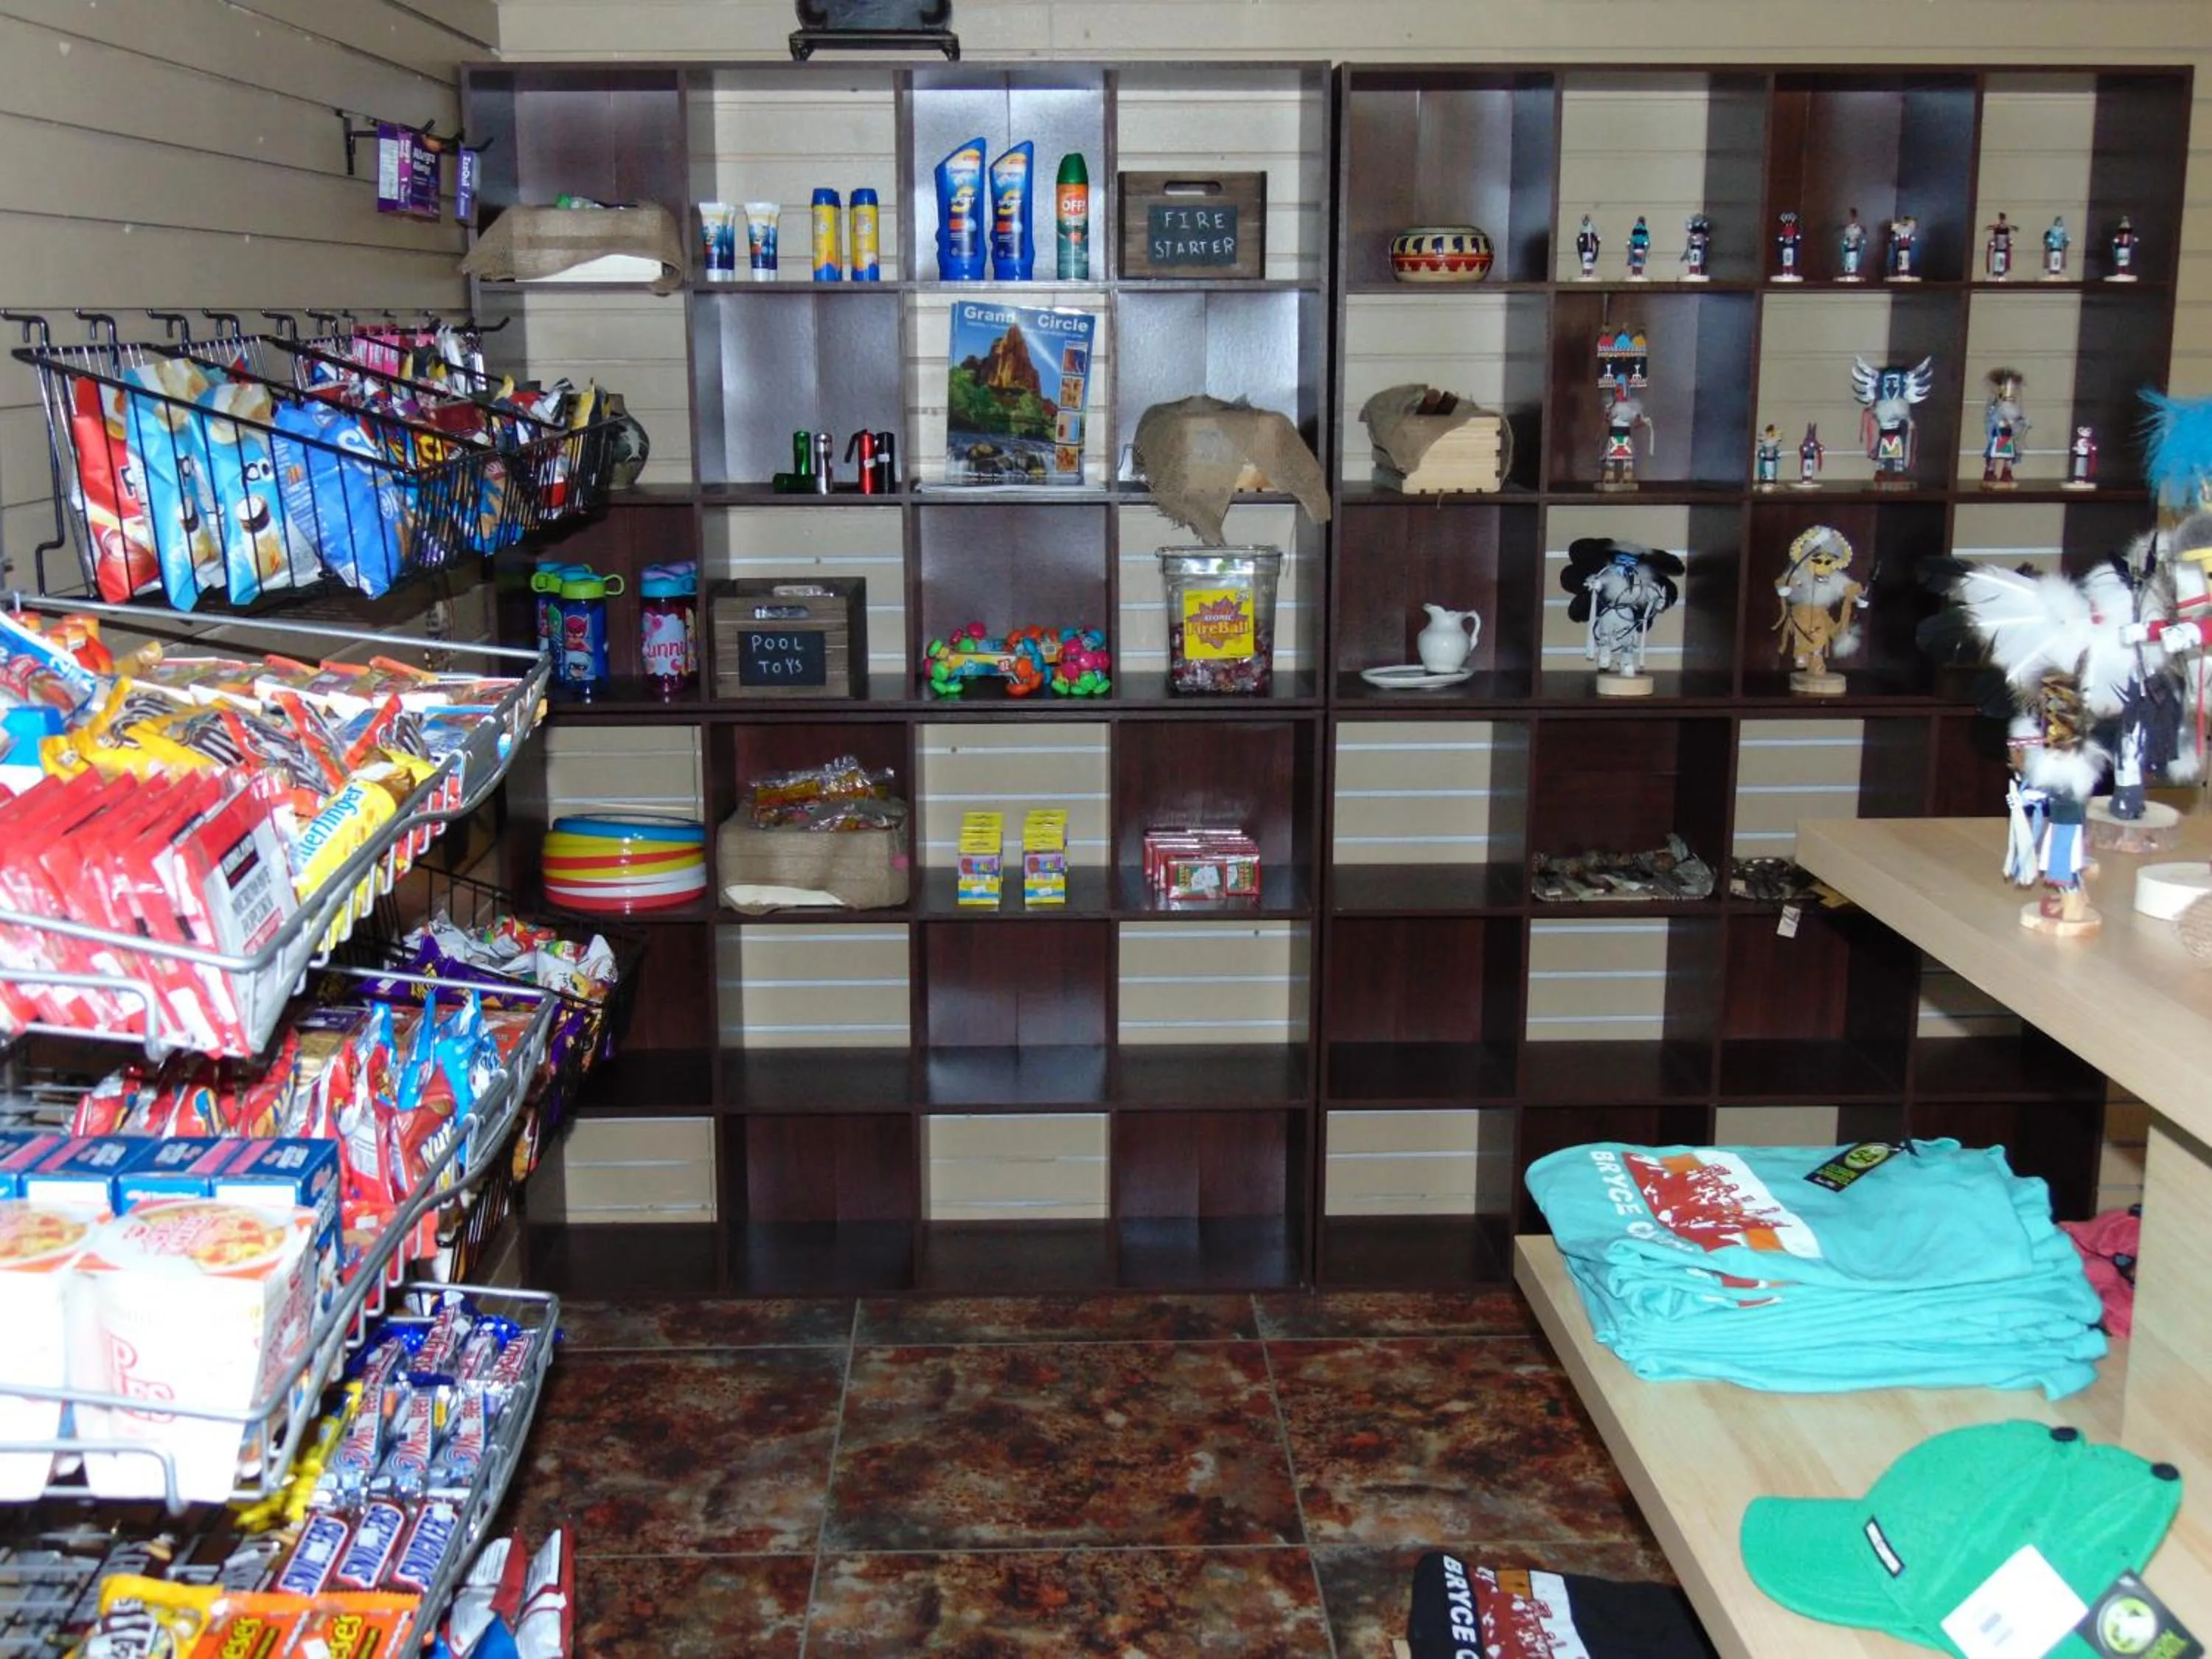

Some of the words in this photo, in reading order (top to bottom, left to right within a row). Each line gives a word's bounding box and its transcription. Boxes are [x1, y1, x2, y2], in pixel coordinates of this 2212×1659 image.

[1165, 212, 1225, 229] FIRE
[1155, 236, 1234, 259] STARTER
[964, 306, 1016, 324] Grand
[1037, 314, 1089, 333] Circle
[751, 634, 804, 653] POOL
[757, 658, 804, 674] TOYS
[295, 785, 363, 867] tterfinger
[1590, 1150, 1644, 1216] BRYCE
[1443, 1554, 1477, 1644] BRYCE
